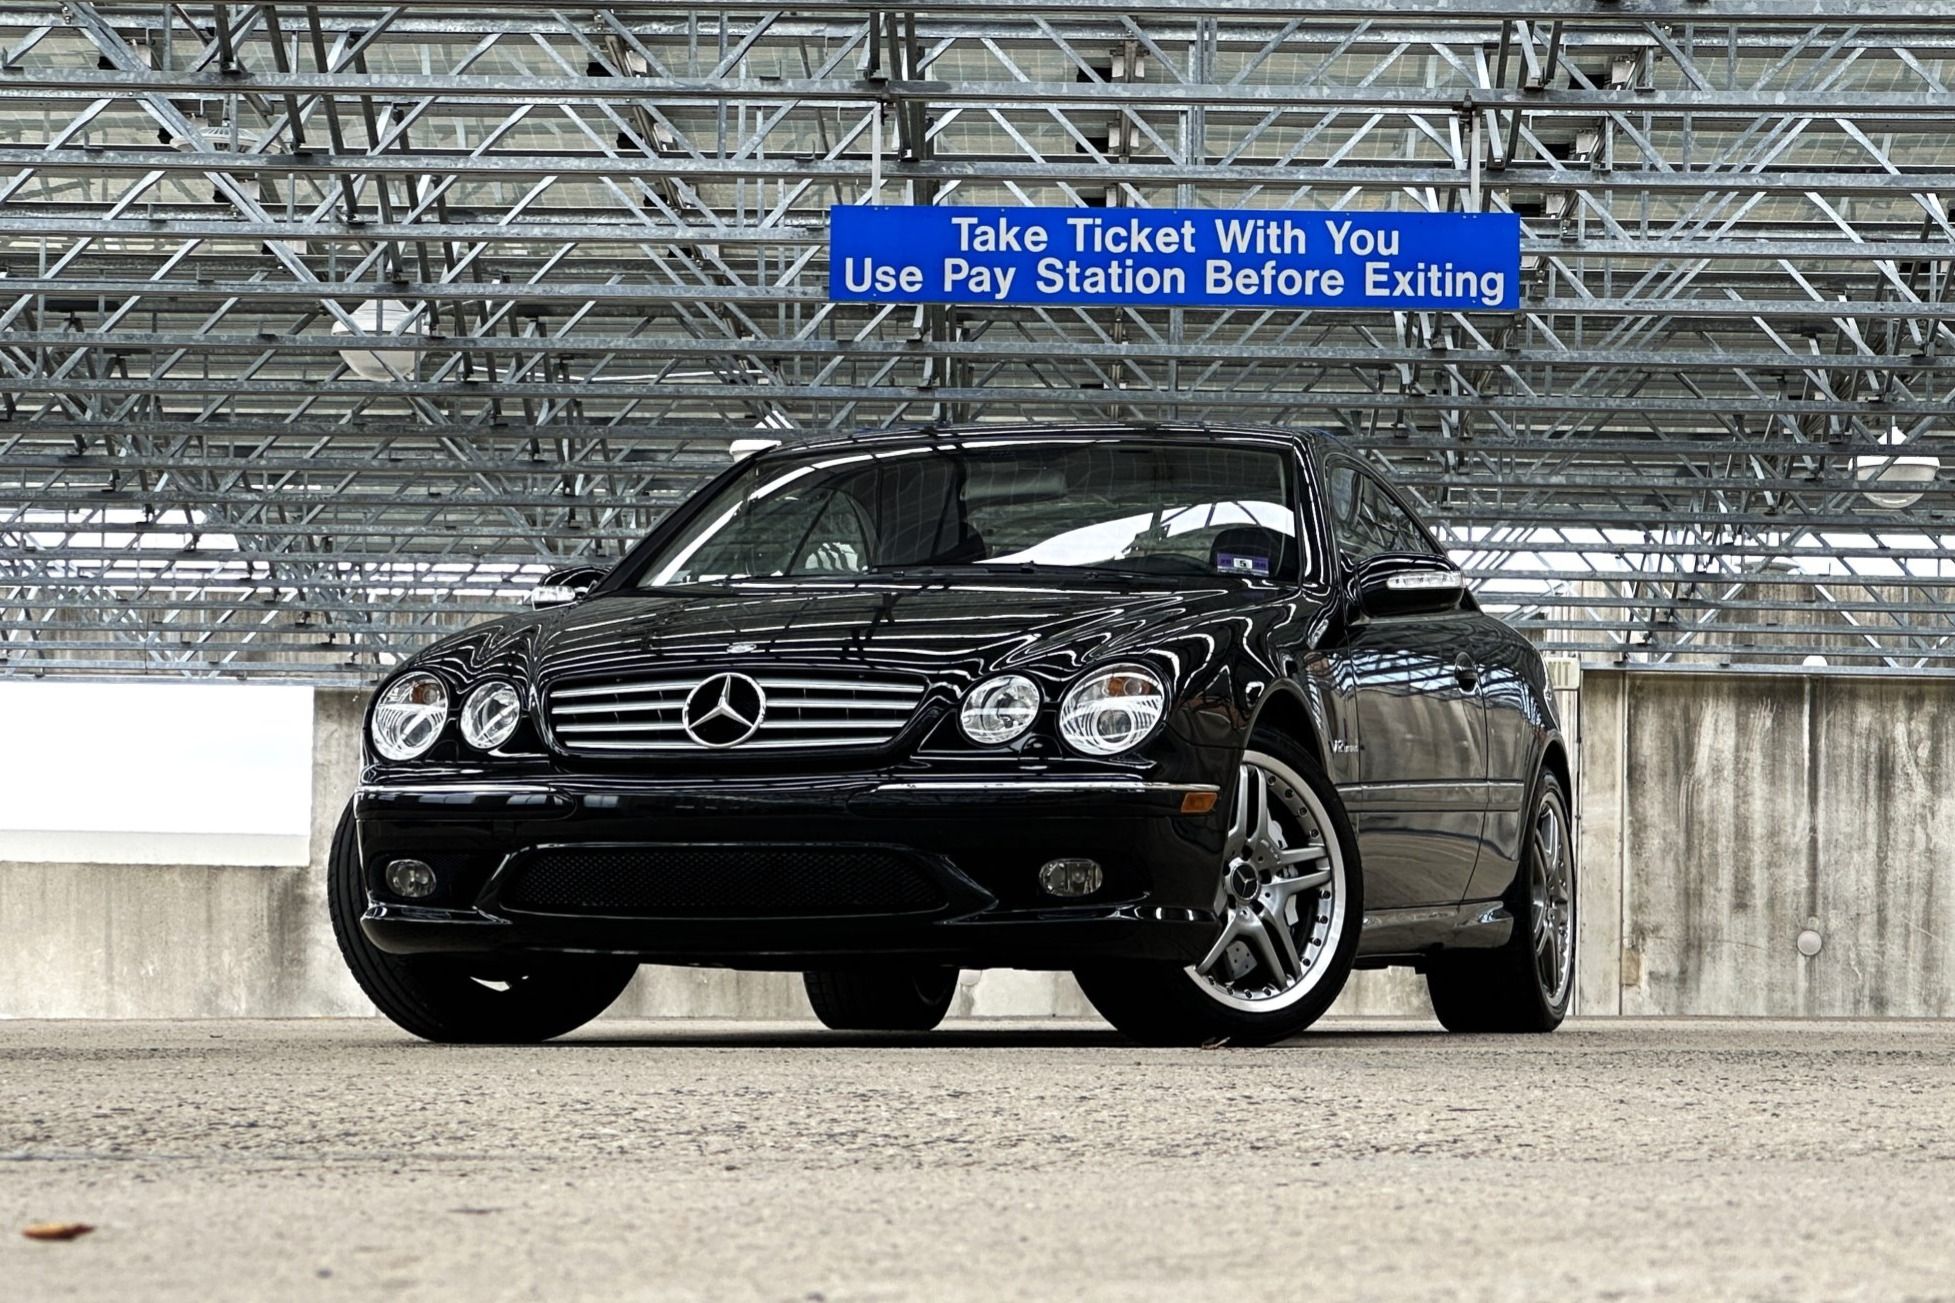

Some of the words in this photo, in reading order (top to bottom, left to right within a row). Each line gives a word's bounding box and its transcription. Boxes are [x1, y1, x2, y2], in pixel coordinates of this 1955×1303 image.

[952, 218, 1048, 252] Take
[1067, 218, 1196, 254] Ticket
[1215, 219, 1306, 254] With
[1326, 220, 1399, 256] You
[846, 258, 924, 293] Use
[944, 258, 1017, 300] Pay
[1037, 258, 1185, 295] Station
[1205, 260, 1345, 297] Before
[1366, 262, 1504, 306] Exiting
